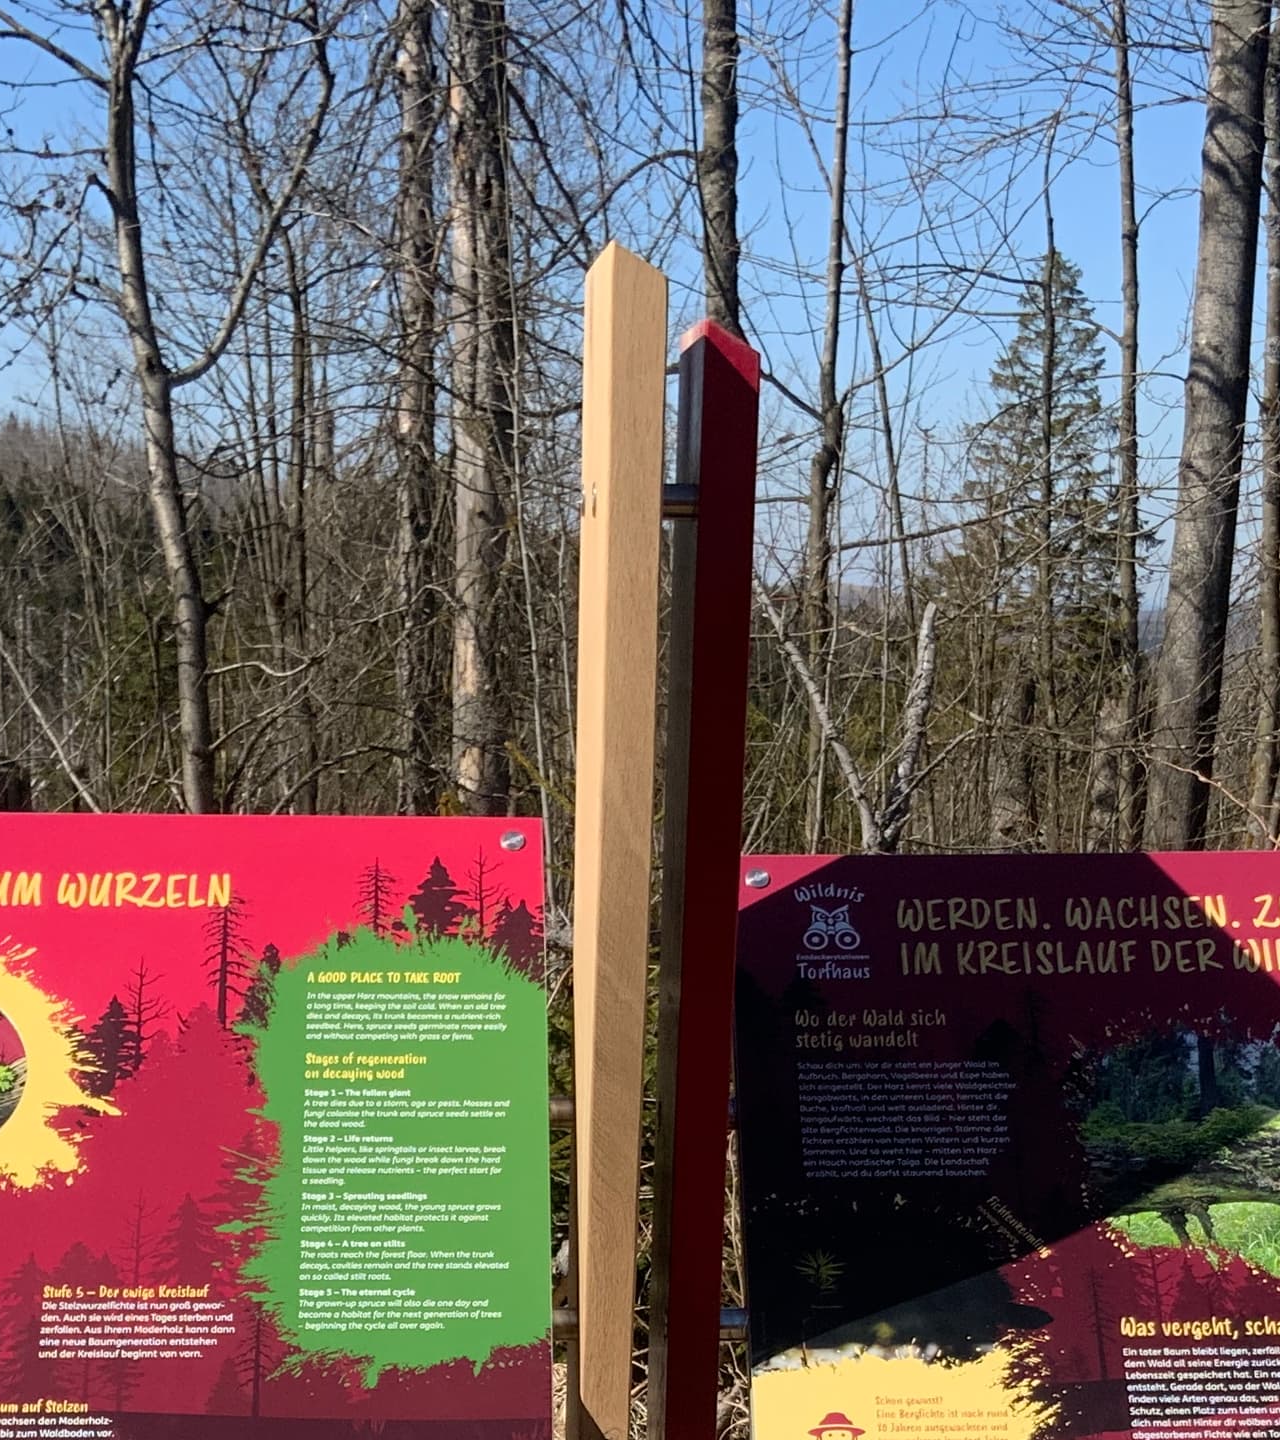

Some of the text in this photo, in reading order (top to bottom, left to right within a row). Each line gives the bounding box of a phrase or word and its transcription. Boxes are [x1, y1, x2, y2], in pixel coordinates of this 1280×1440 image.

[57, 873, 230, 907] WURZELN
[794, 882, 865, 902] Wildnis
[897, 898, 1051, 931] WERDEN.
[1065, 896, 1240, 930] WACHSEN.
[901, 942, 942, 975] IM
[957, 941, 1137, 974] KREISLAUF
[1151, 939, 1224, 972] DER
[307, 972, 461, 983] A GOOD PLACE TO TAKE ROOT
[796, 962, 871, 980] Torfhaus
[795, 1009, 946, 1027] Wo der Wald sich
[796, 1030, 918, 1052] stetig wandelt
[306, 1052, 427, 1066] Stages of regeneration
[305, 1068, 404, 1082] on decaying wood
[304, 1089, 330, 1098] Stage
[388, 1089, 411, 1098] giant
[302, 1192, 327, 1202] Stage
[328, 1192, 334, 1200] 3
[343, 1192, 385, 1202] Sprouting
[386, 1192, 428, 1202] seedlings
[43, 1284, 73, 1298] Stufe
[76, 1286, 84, 1298] 5
[99, 1285, 120, 1298] Der
[122, 1286, 155, 1300] ewige
[158, 1284, 210, 1298] Kreislauf
[1120, 1317, 1156, 1337] Was
[1162, 1317, 1238, 1340] vergeht,
[39, 1338, 60, 1346] eine
[88, 1338, 168, 1348] Baumgeneration
[169, 1337, 218, 1346] entstehen
[38, 1350, 58, 1358] und
[59, 1350, 76, 1358] der
[78, 1349, 120, 1358] Kreislauf
[121, 1350, 158, 1360] beginnt
[22, 1398, 44, 1413] auf
[45, 1400, 88, 1413] Stelzen
